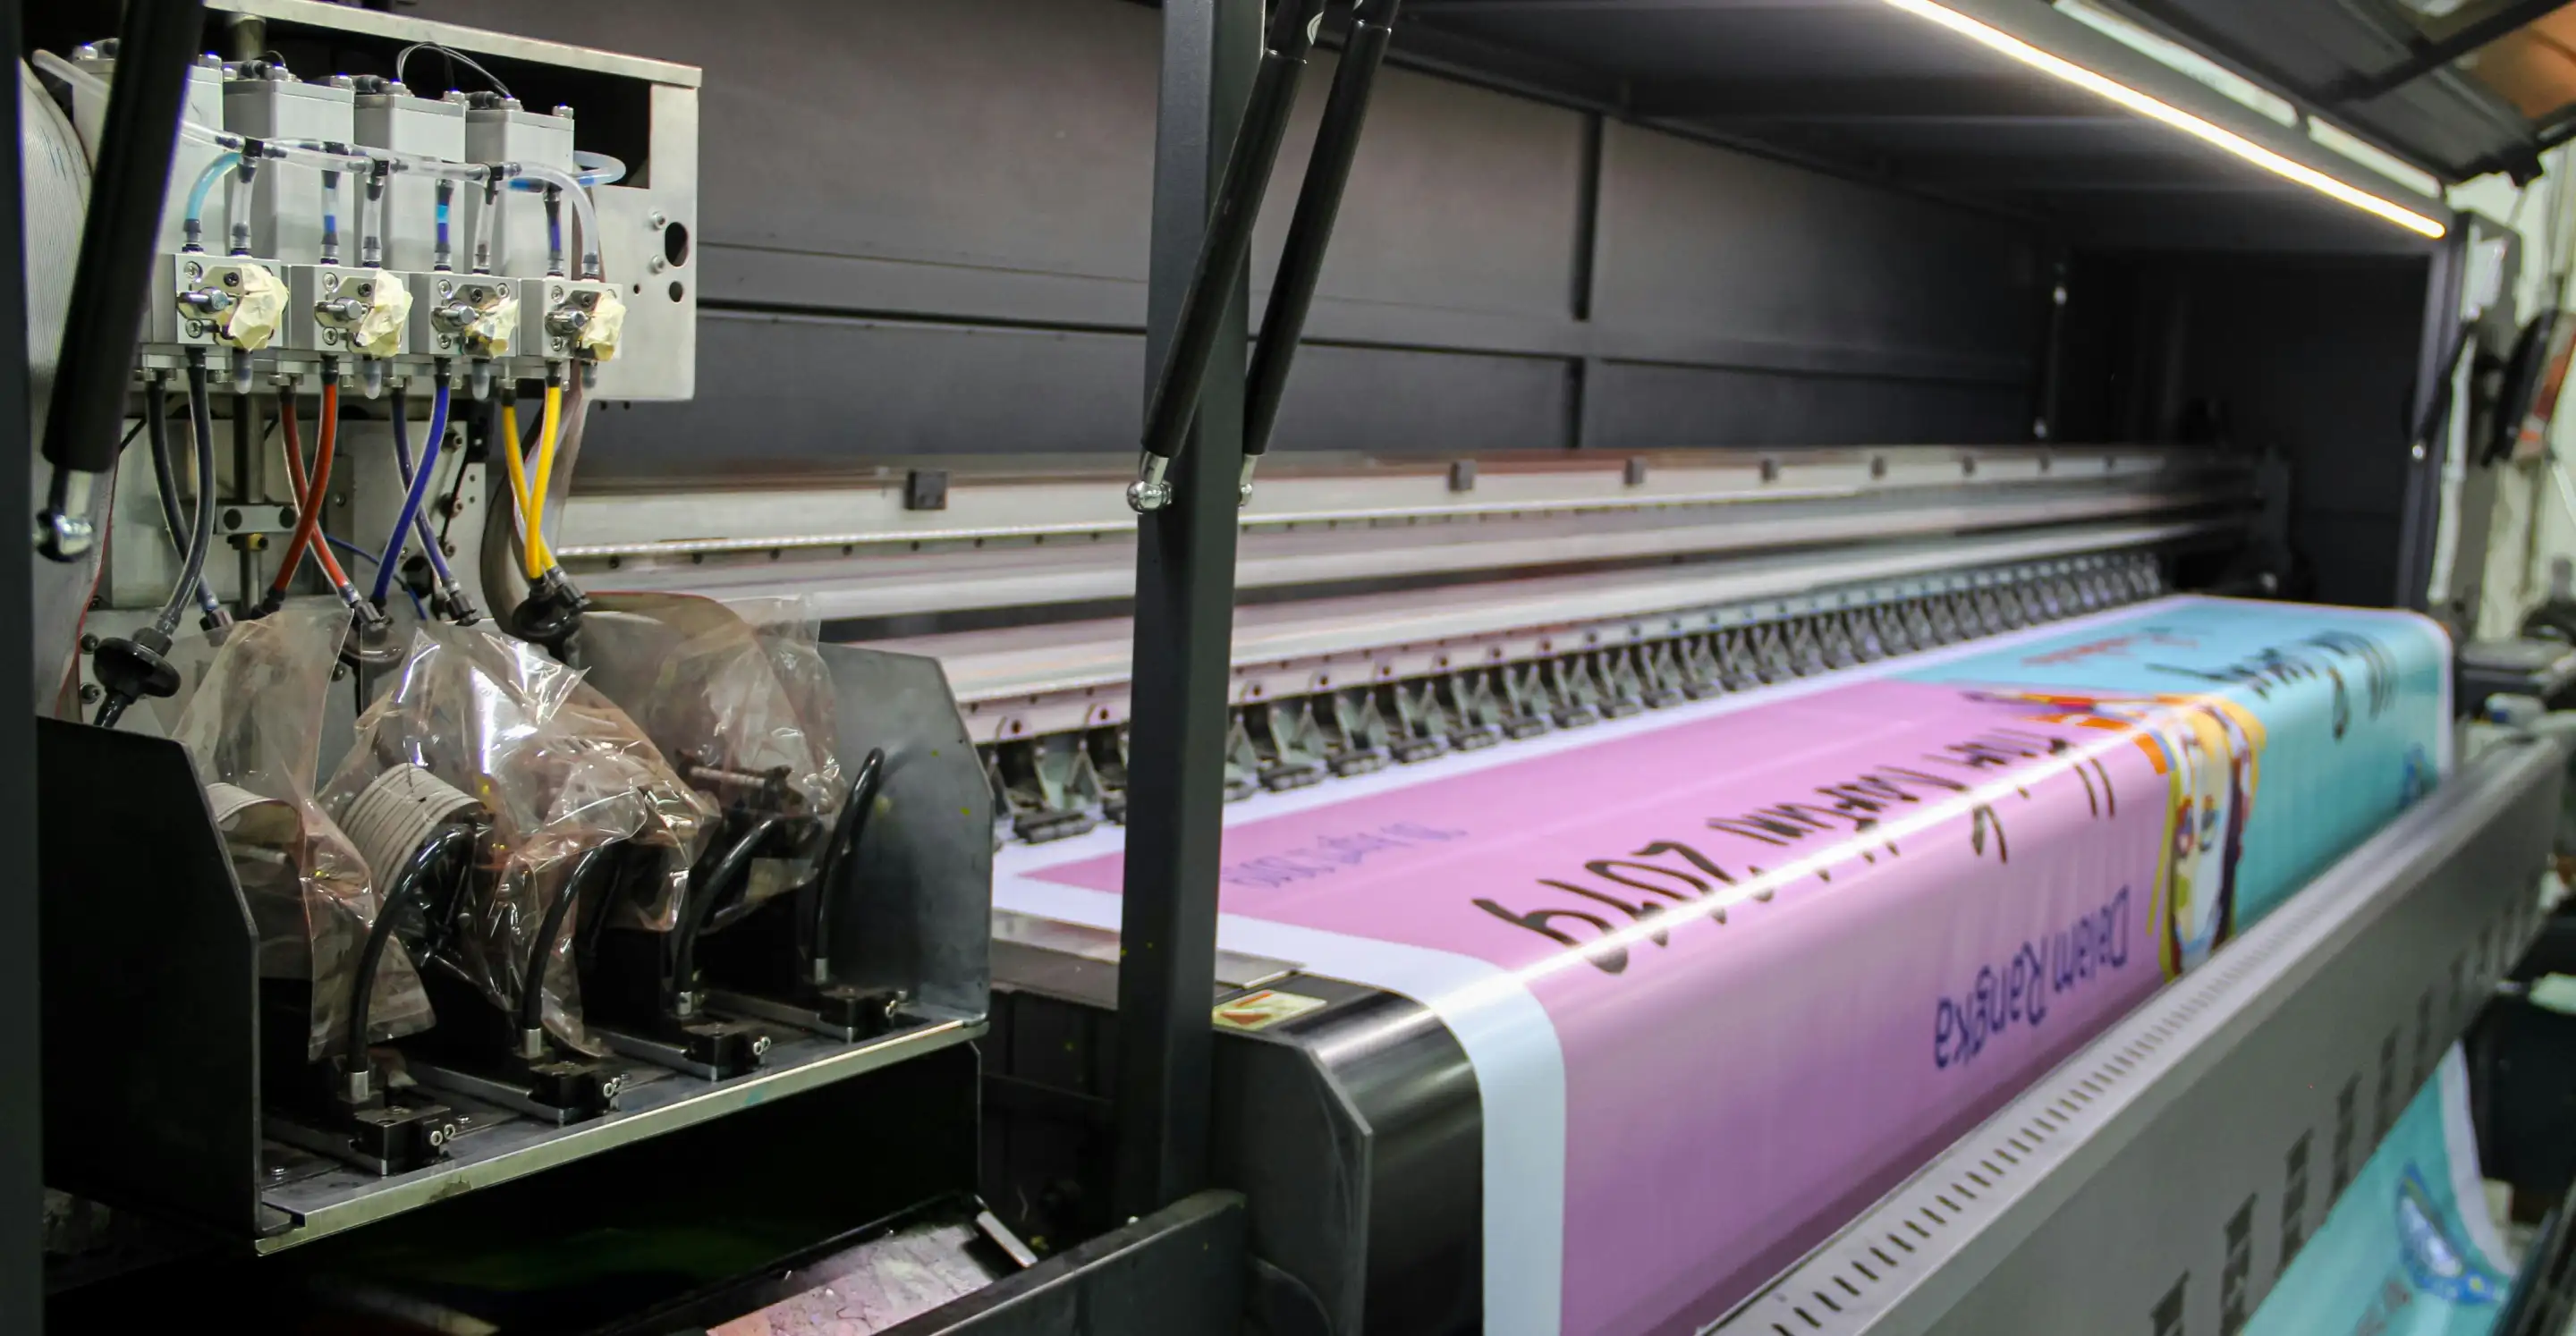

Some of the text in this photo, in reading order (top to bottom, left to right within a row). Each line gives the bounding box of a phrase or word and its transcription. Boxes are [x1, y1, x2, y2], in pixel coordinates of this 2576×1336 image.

[1470, 840, 1774, 976] 2019
[1934, 884, 2131, 1070] Dalam Rangka
